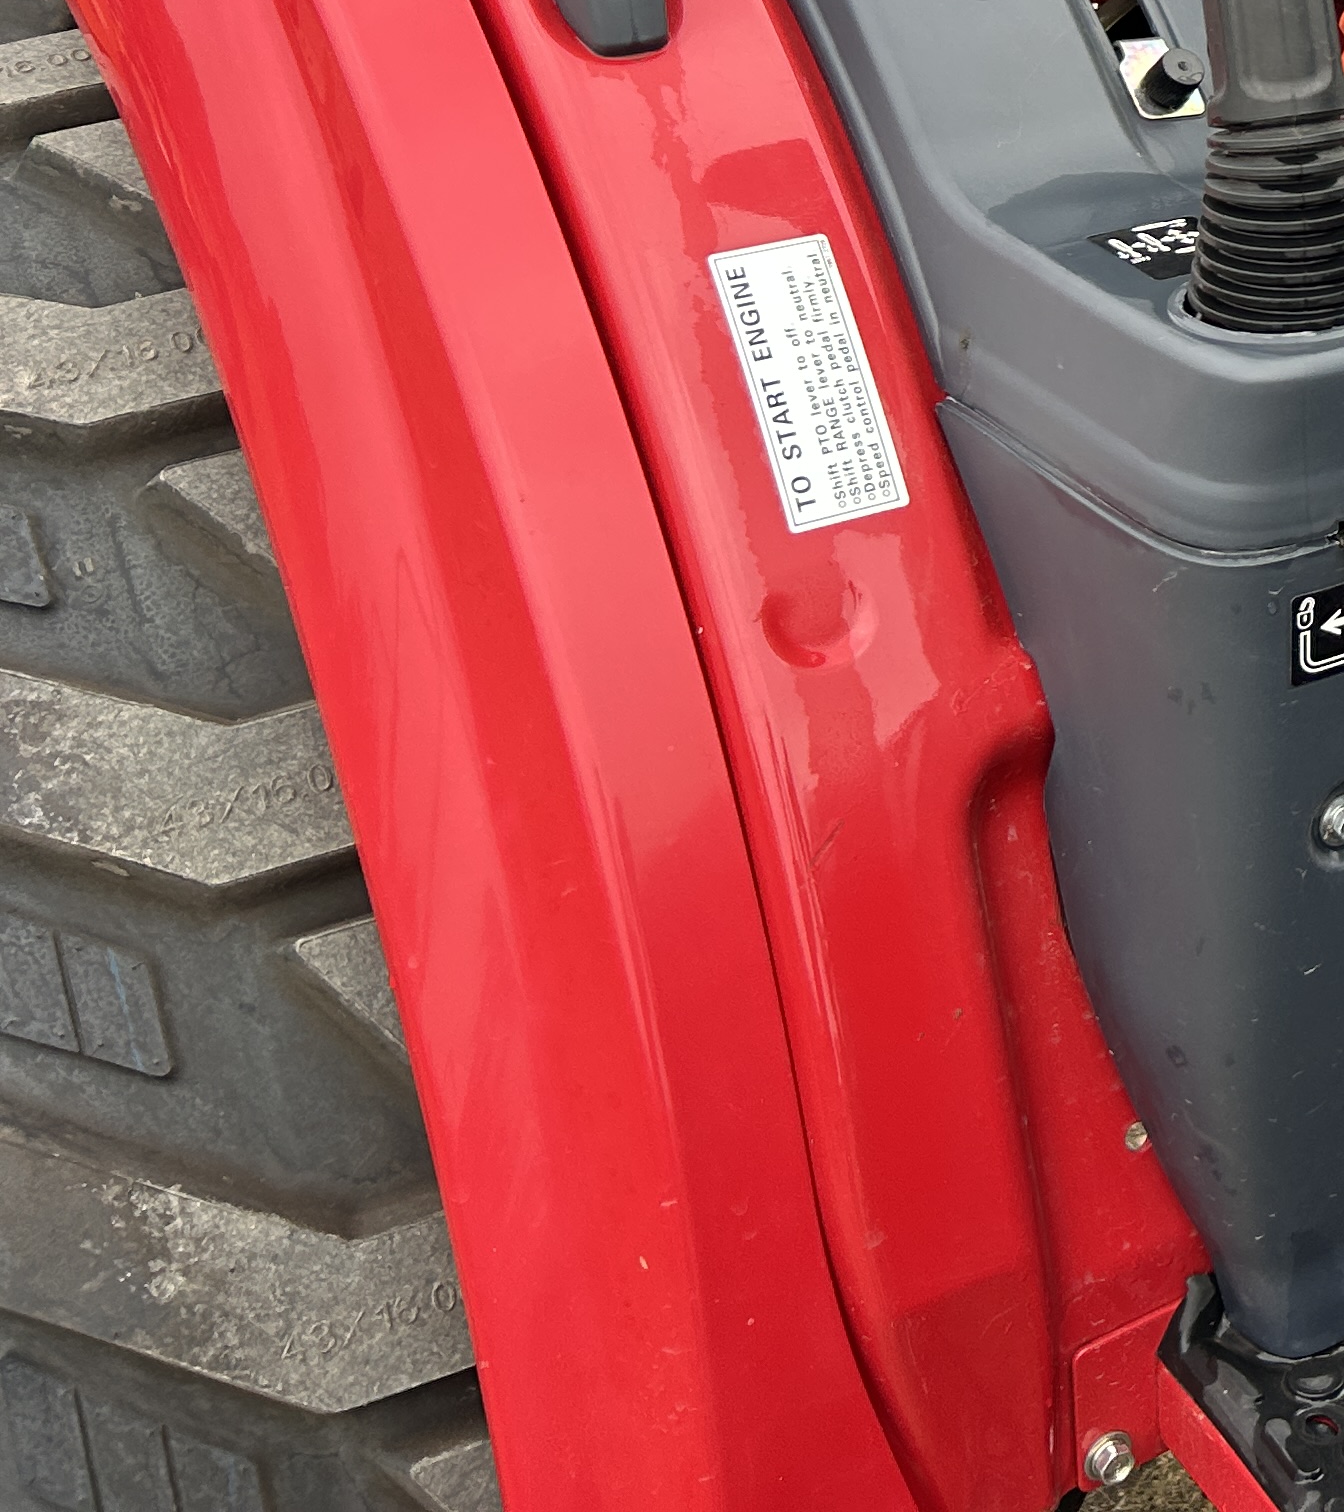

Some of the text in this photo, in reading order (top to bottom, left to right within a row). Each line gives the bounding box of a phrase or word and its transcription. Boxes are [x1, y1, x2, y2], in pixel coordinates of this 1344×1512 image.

[829, 311, 839, 324] in
[804, 329, 815, 344] to
[817, 330, 840, 369] pedal
[833, 333, 857, 371] pedal
[796, 355, 807, 370] to
[811, 353, 828, 388] lever
[726, 267, 815, 511] TO START ENGINE
[804, 380, 821, 415] lever
[834, 378, 855, 423] clutch
[848, 381, 873, 433] control
[815, 424, 832, 454] PTO
[823, 398, 847, 450] RANGE
[827, 462, 846, 499] Shift
[842, 459, 860, 495] Shift
[852, 432, 875, 492] Depress
[867, 442, 890, 488] Speed
